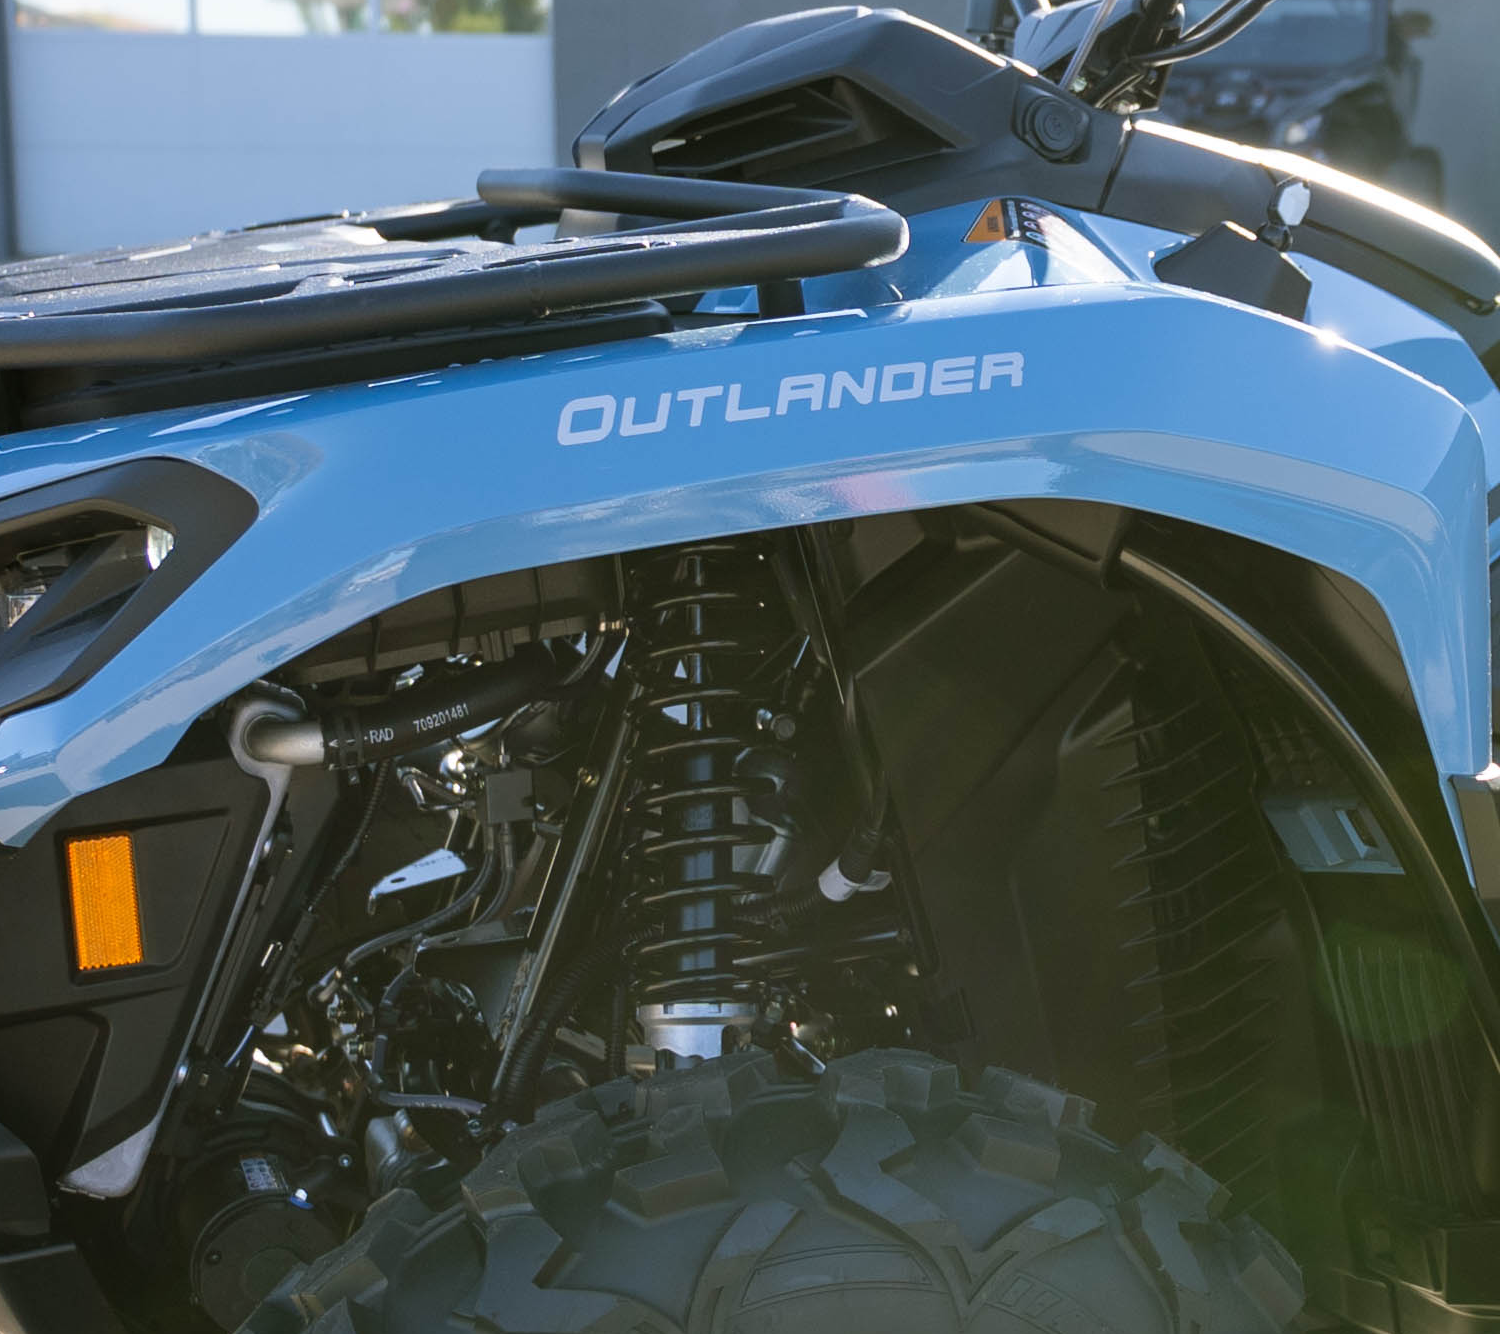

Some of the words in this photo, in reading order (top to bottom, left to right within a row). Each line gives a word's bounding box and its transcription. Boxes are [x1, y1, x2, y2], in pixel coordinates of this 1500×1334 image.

[556, 351, 1025, 447] OUTLANDER
[368, 727, 395, 745] RAD
[412, 702, 470, 734] 709201481
